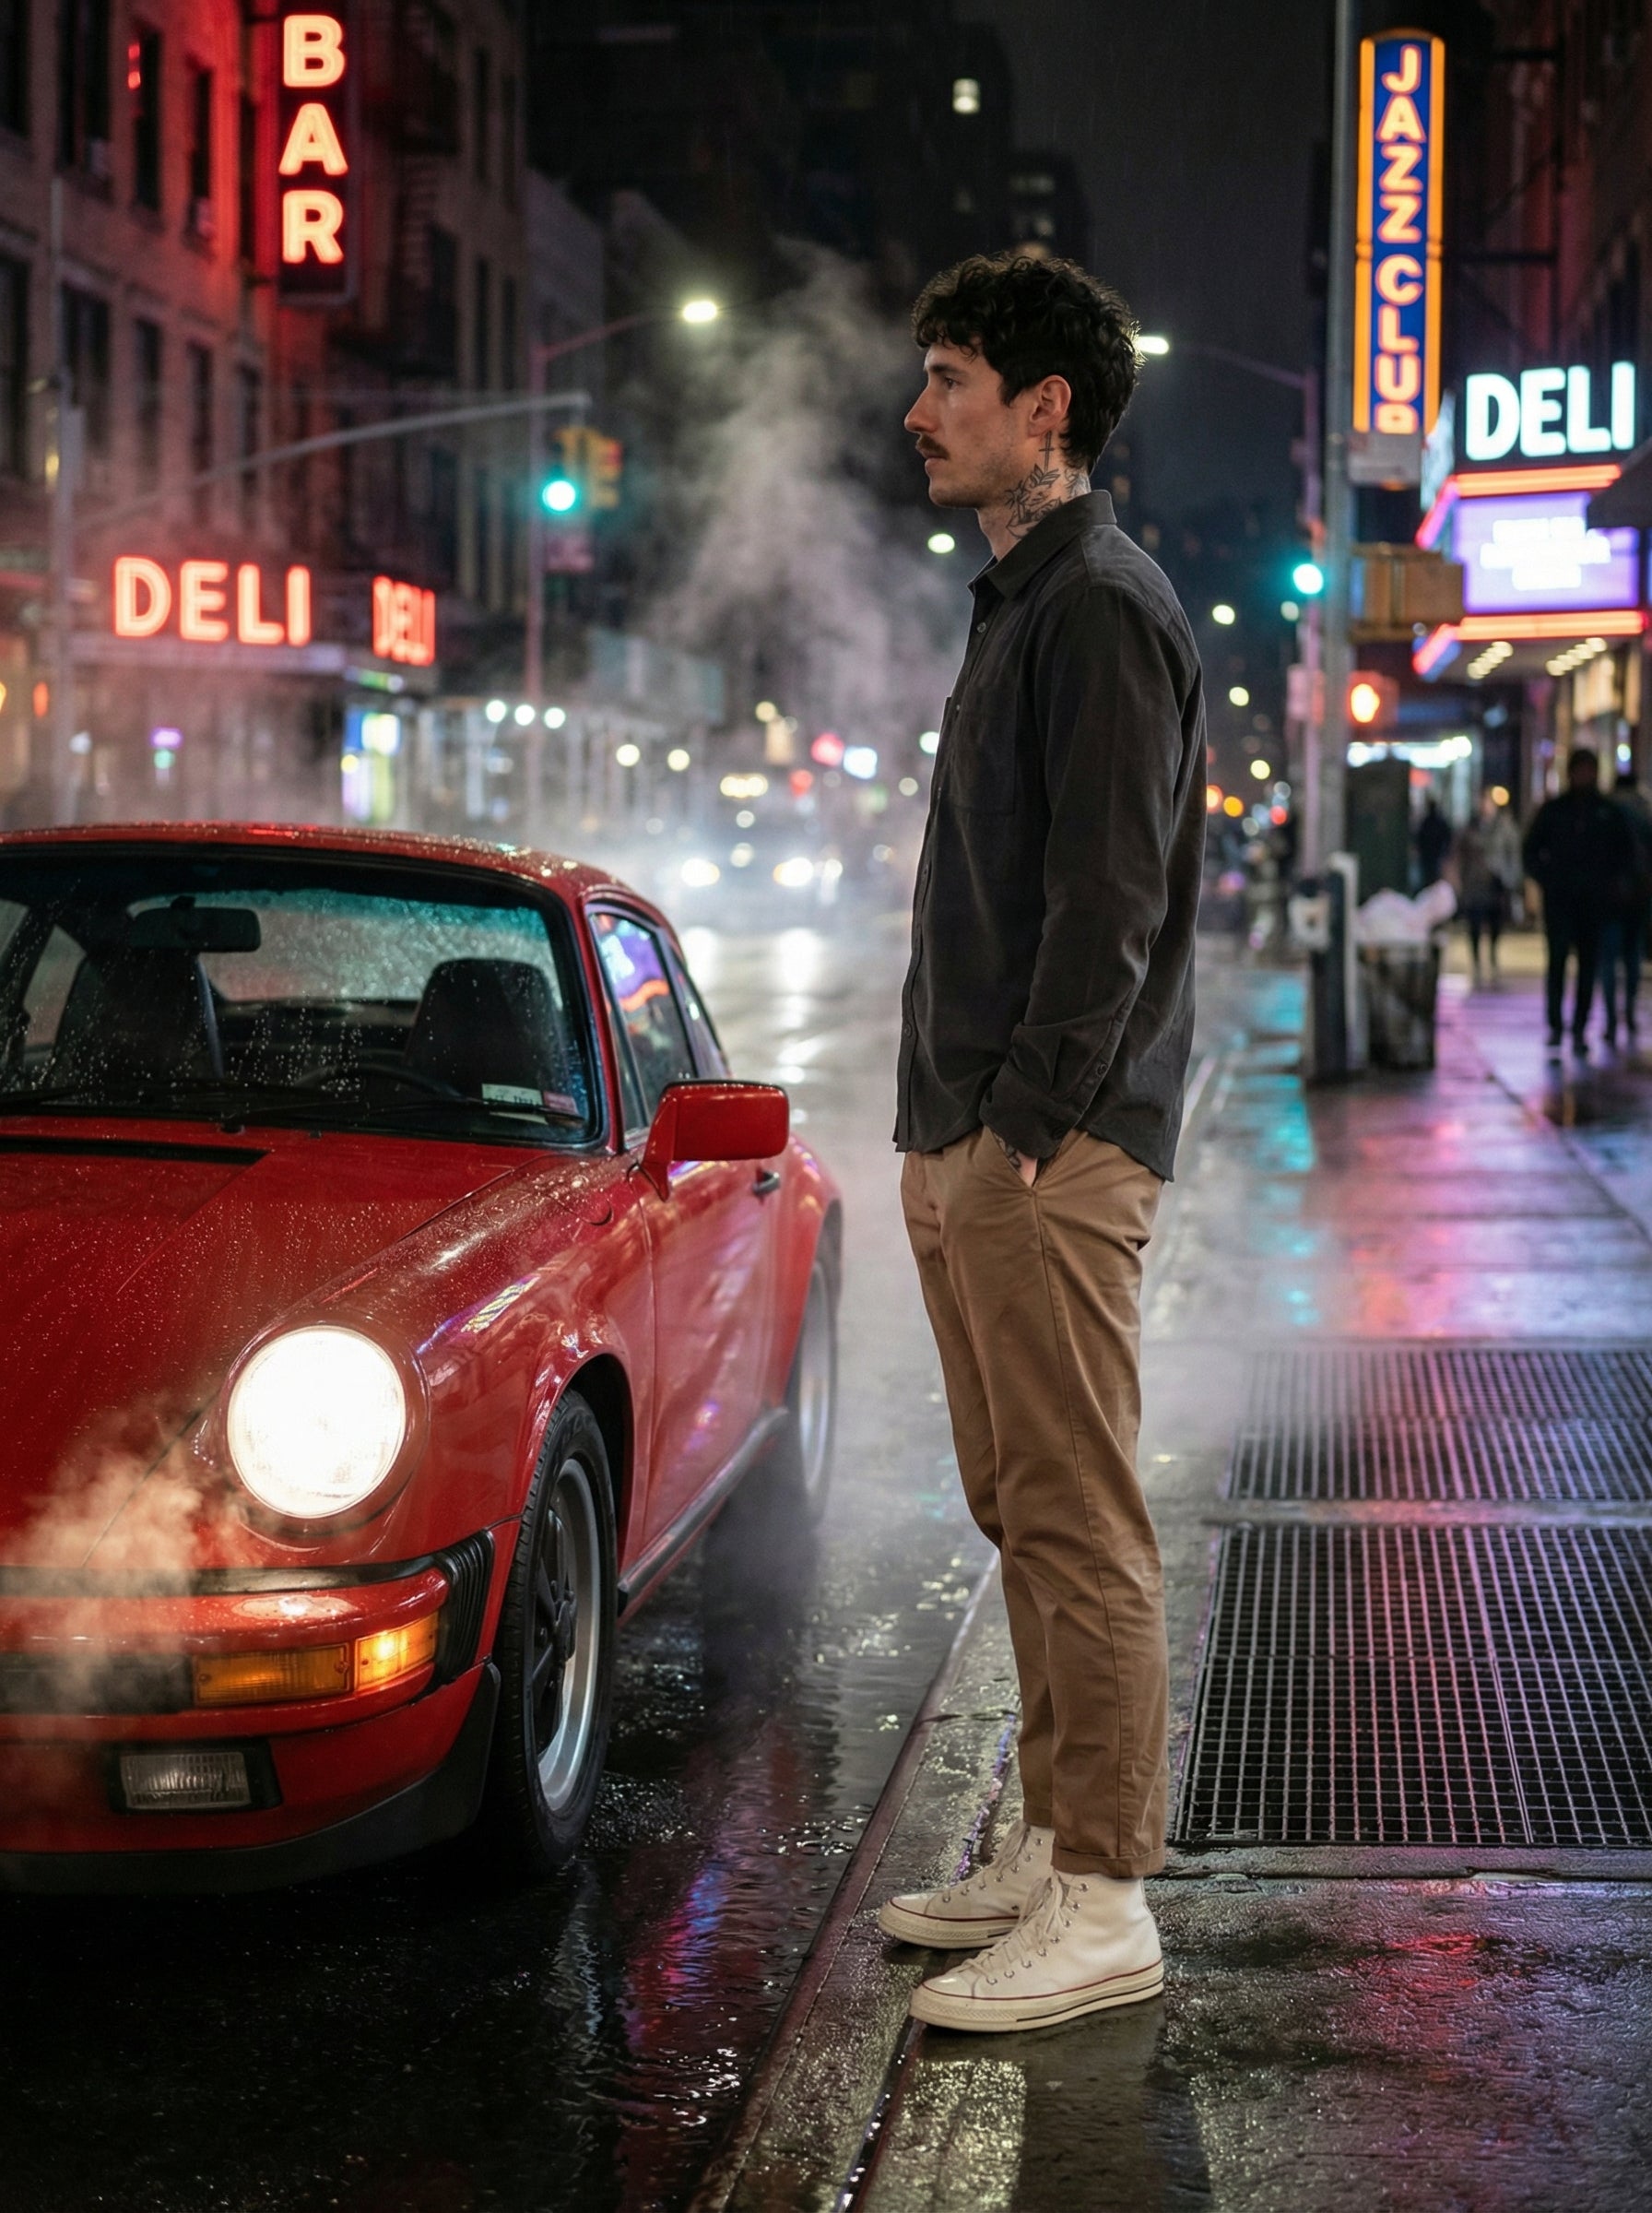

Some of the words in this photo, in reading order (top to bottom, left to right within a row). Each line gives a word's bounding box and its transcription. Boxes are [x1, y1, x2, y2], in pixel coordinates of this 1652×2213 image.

[278, 14, 348, 265] BAR
[1375, 43, 1426, 244] JAZZ
[1465, 361, 1636, 461] DELI
[113, 555, 312, 645] DELI
